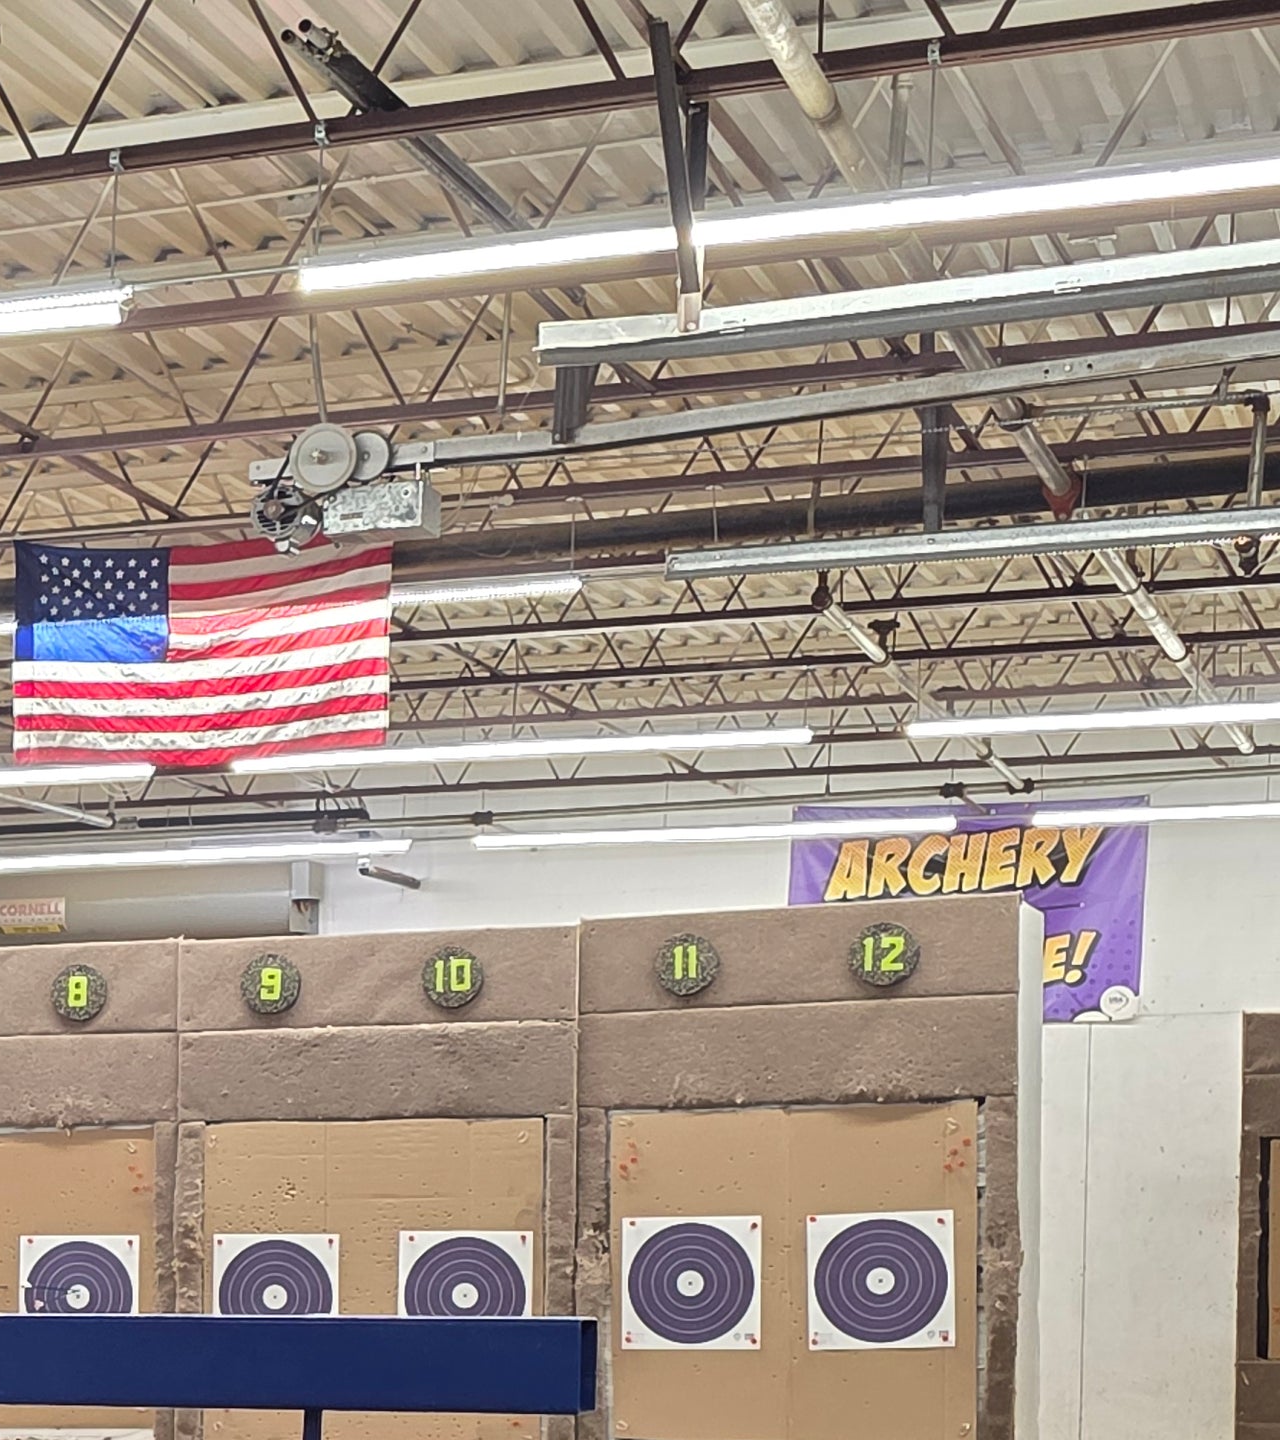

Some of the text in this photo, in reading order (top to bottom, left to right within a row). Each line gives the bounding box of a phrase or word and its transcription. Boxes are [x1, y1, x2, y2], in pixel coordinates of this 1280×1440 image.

[824, 826, 1104, 902] ARCHERY
[673, 945, 697, 980] 11
[862, 935, 906, 972] 12
[67, 975, 88, 1008] 8
[260, 967, 282, 1000] 9
[434, 956, 472, 993] 10
